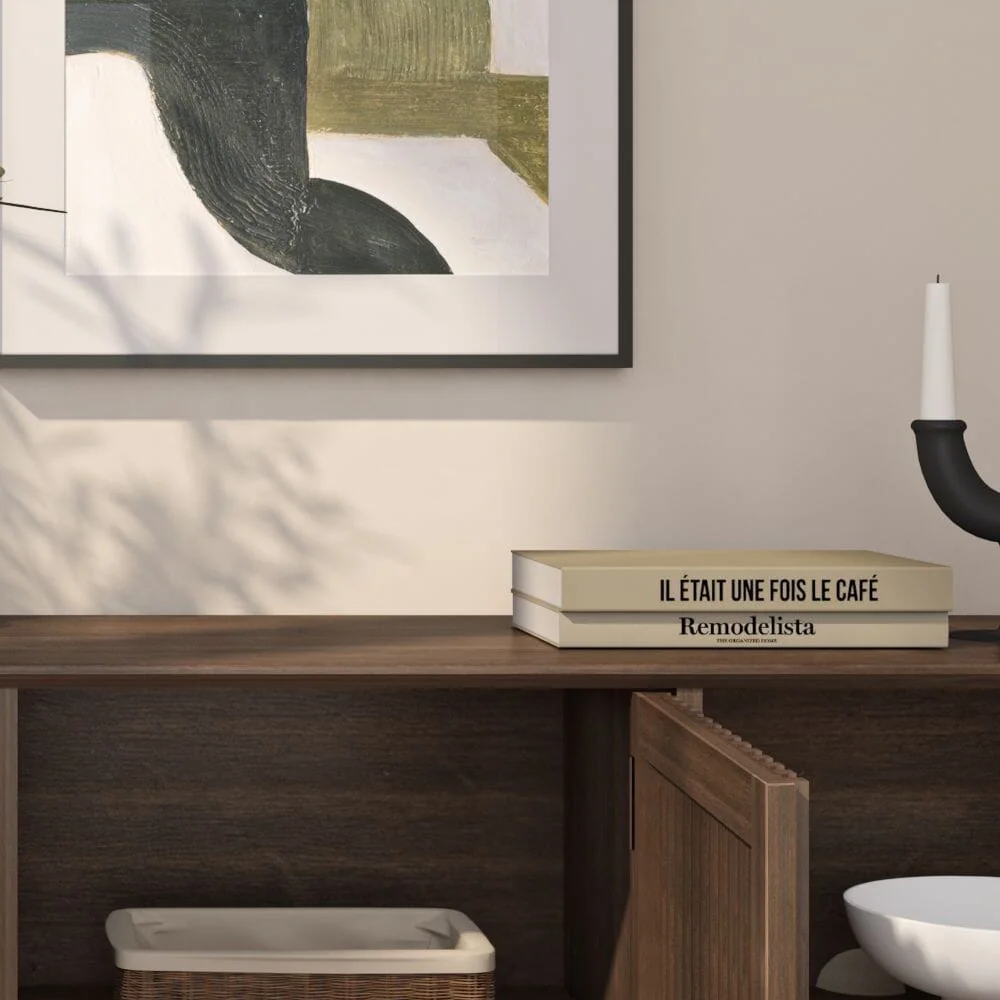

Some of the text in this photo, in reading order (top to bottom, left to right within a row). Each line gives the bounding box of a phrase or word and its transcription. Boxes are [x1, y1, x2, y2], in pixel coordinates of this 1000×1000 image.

[660, 574, 879, 602] IL ÉTAIT UNE FOIS LE CAFÉ
[678, 615, 817, 636] Remodelista
